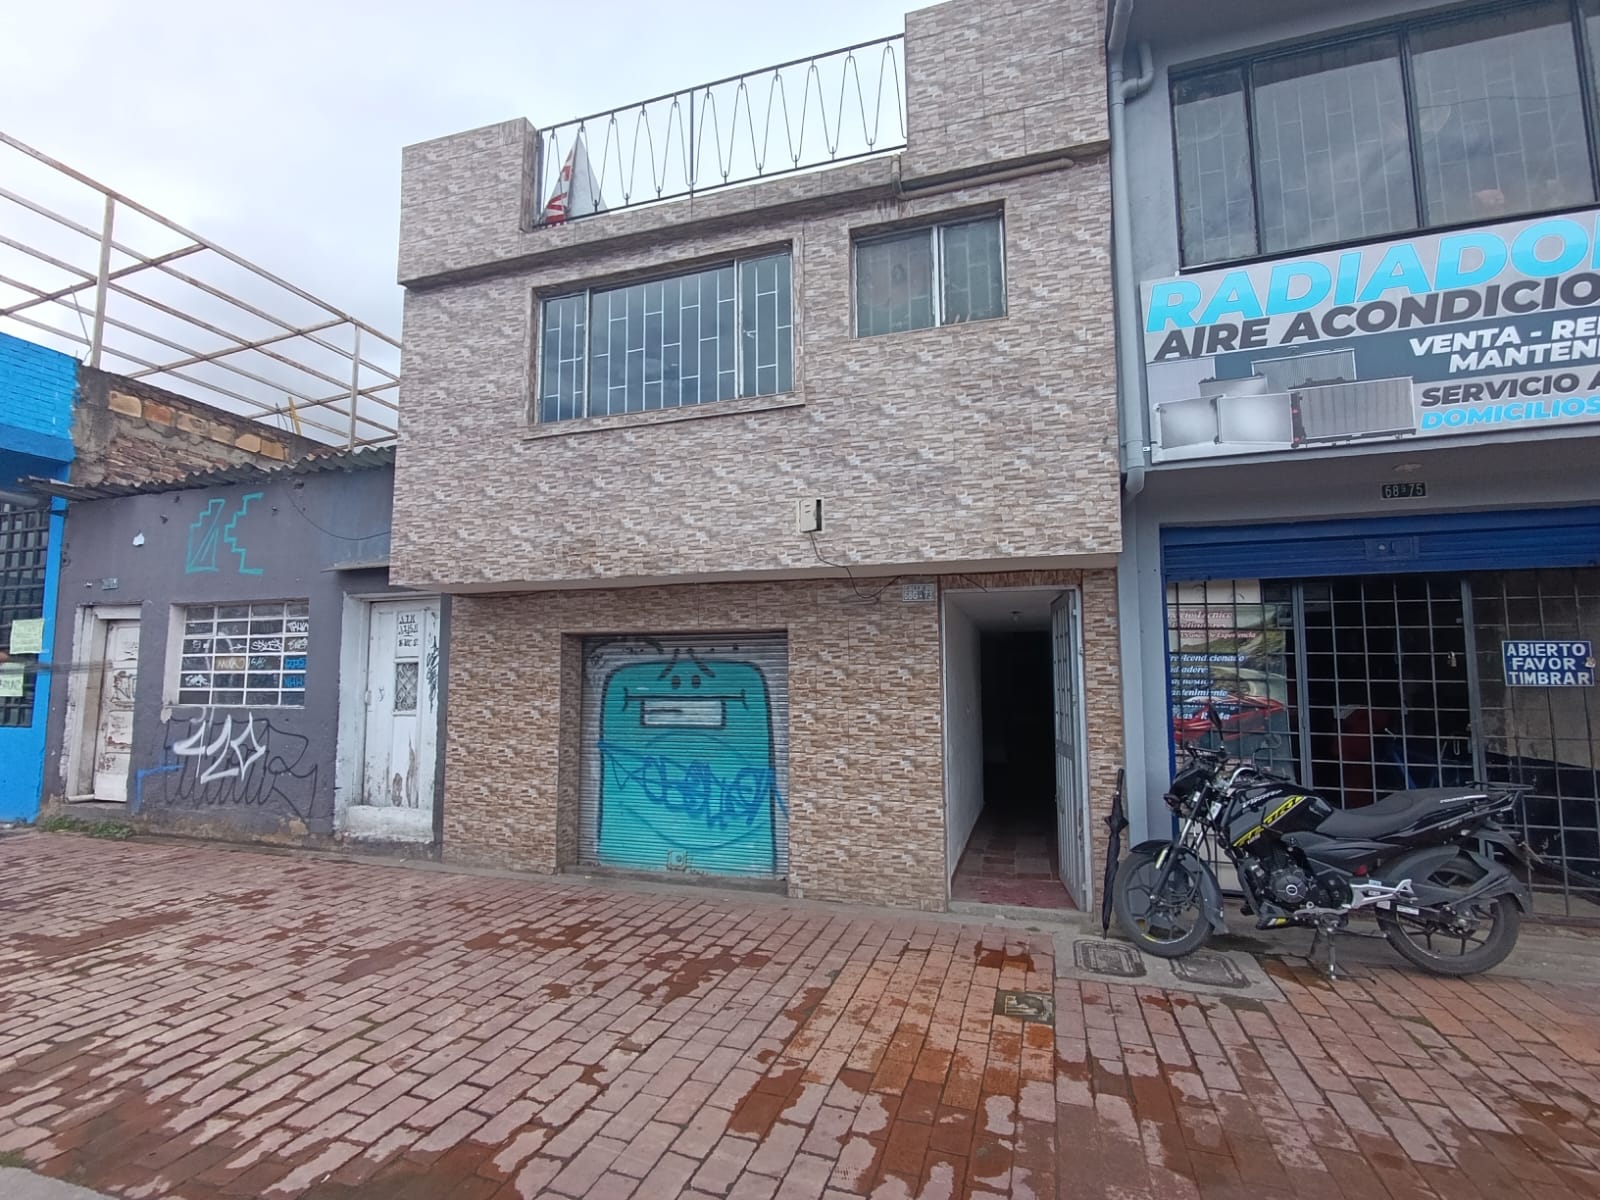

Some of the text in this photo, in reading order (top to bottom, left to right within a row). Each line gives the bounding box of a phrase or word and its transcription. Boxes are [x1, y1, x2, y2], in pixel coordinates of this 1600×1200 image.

[1146, 213, 1600, 333] RADIADO
[1154, 317, 1270, 360] AIRE
[1409, 325, 1521, 356] VENTA
[1551, 316, 1600, 340] RE
[1449, 338, 1600, 374] MANTEN
[1421, 373, 1579, 408] SERVICIO
[1507, 643, 1586, 657] ABIERTO
[1511, 657, 1577, 671] FAVOR
[1508, 671, 1590, 685] TIMBRAR
